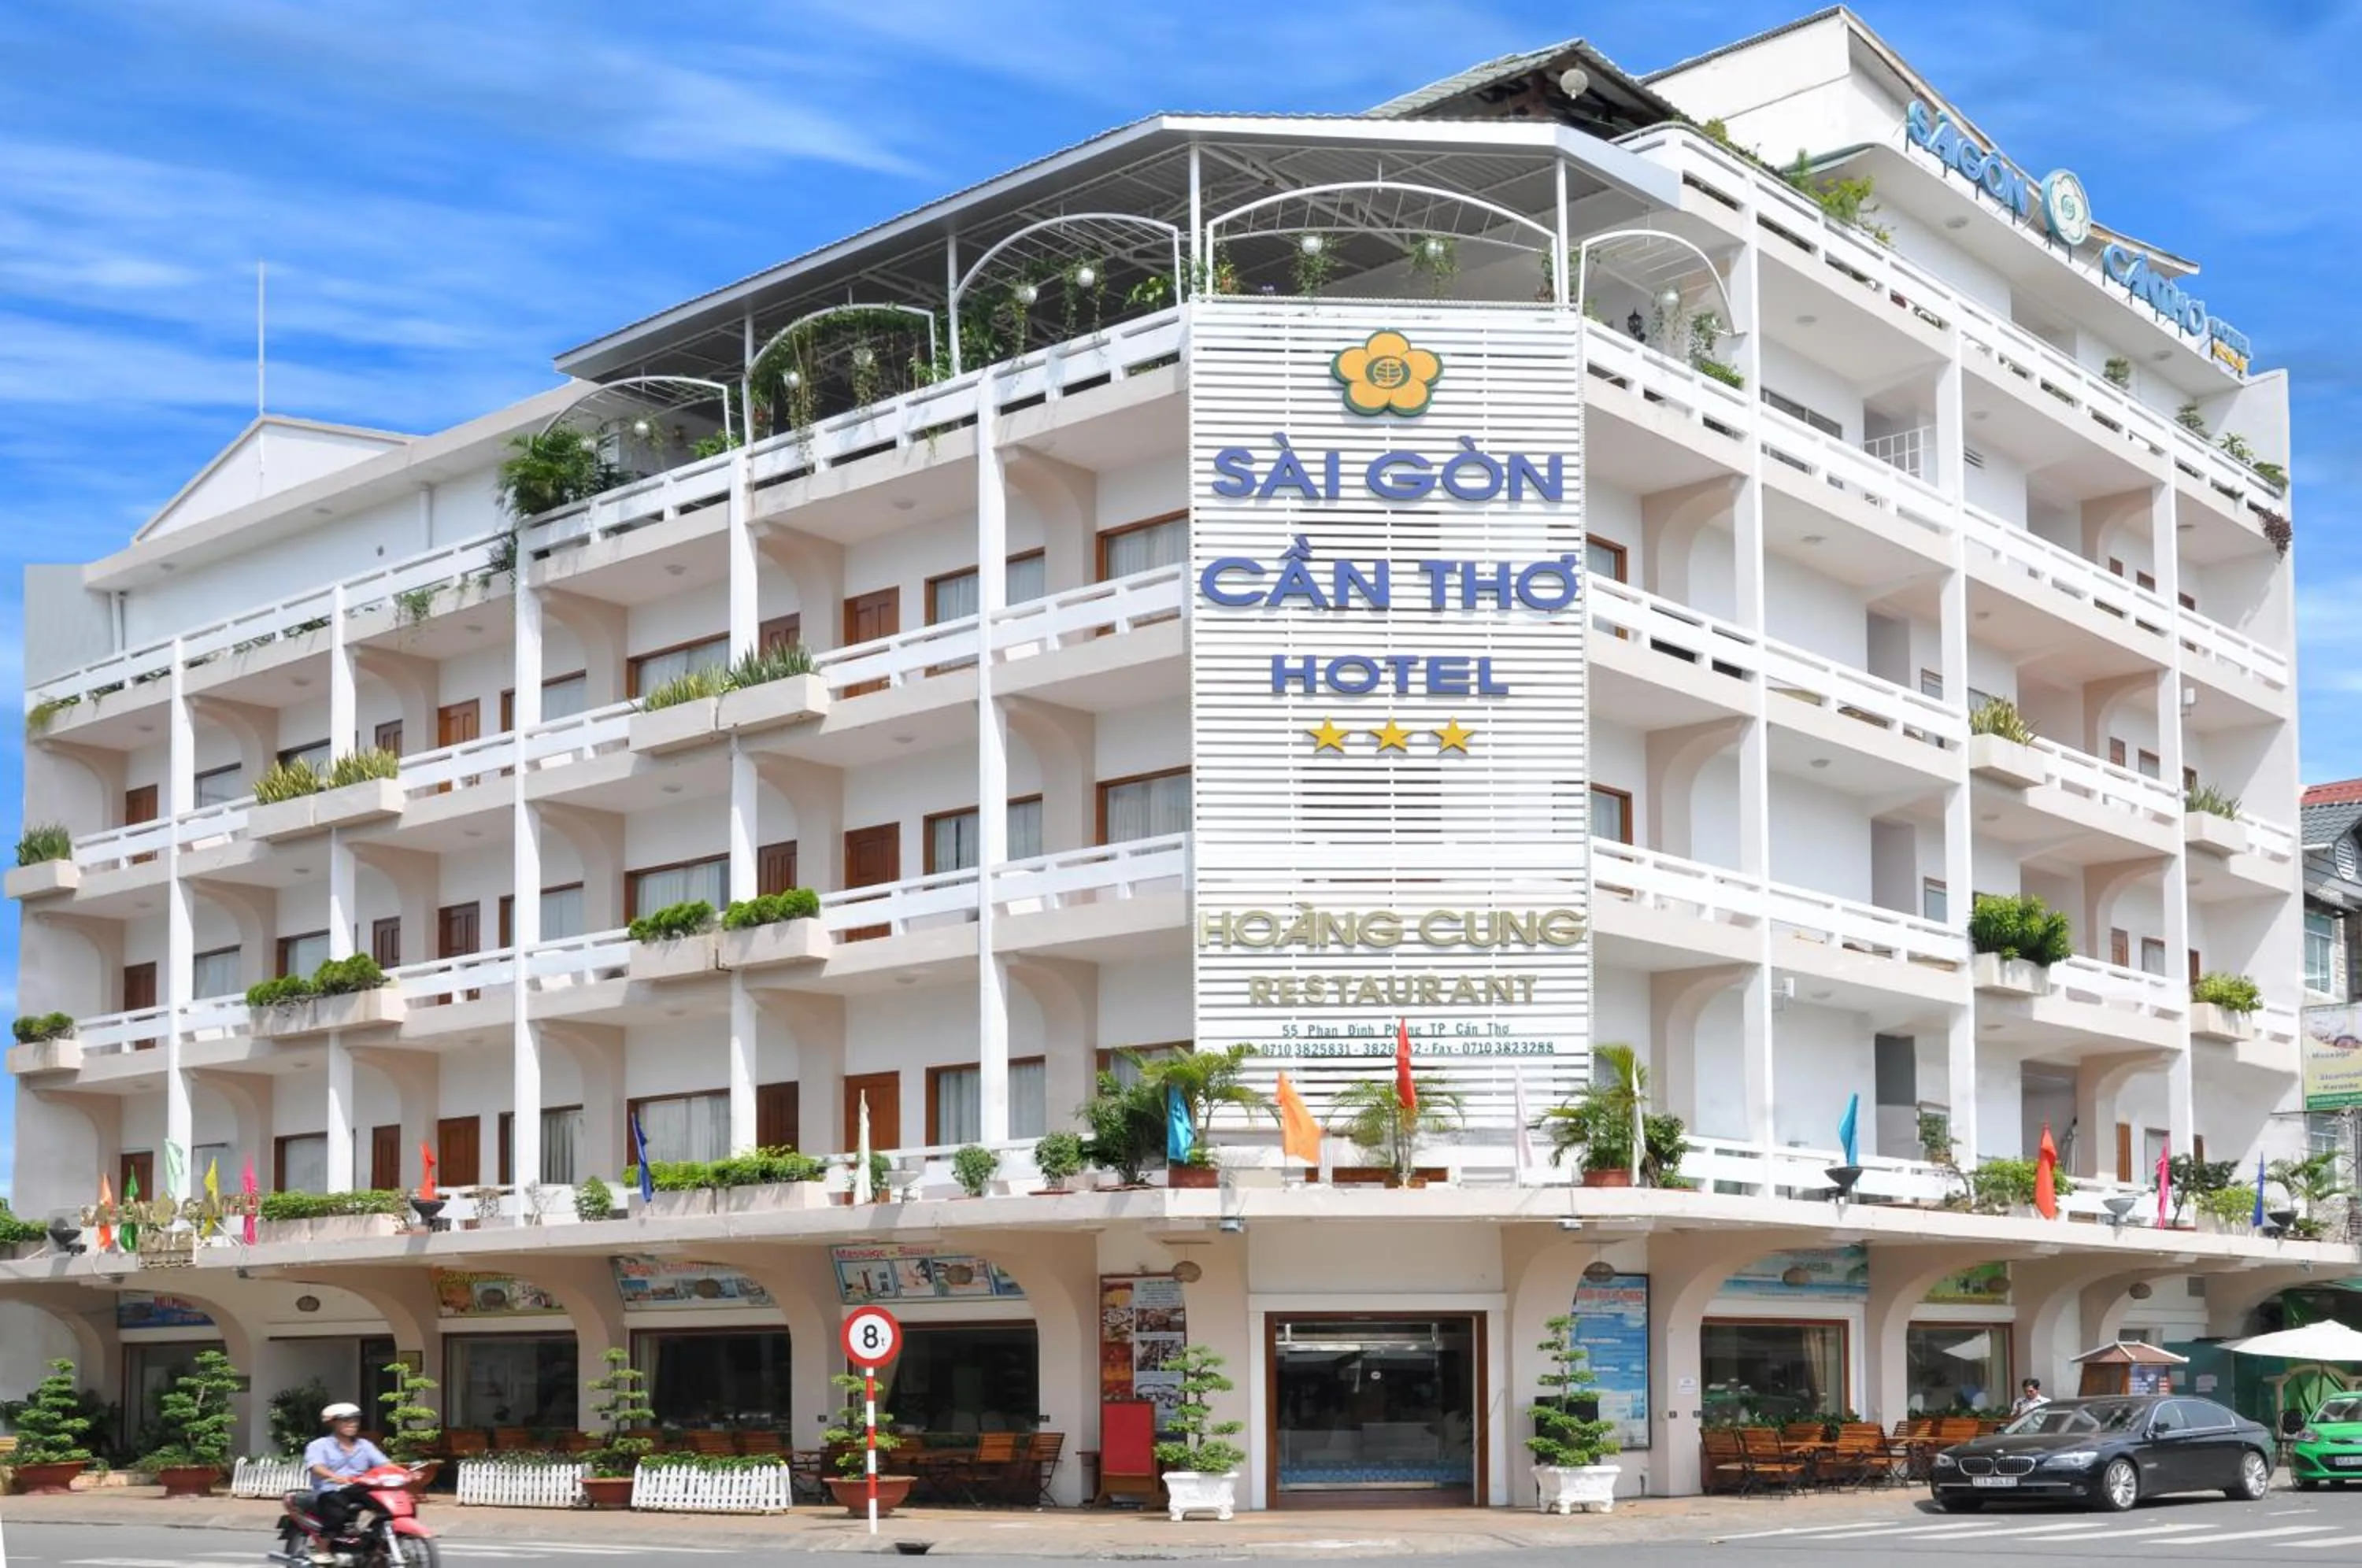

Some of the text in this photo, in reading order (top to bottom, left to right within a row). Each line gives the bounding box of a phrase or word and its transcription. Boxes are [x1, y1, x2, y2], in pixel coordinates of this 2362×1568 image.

[1212, 431, 1564, 502] SÀI GÒN
[1200, 534, 1579, 611] CẦN THƠ
[1271, 654, 1509, 695] HOTEL
[1198, 901, 1587, 948] HOÀNG CUNG
[1249, 974, 1538, 1008] RESTAURANT
[1282, 1024, 1298, 1037] 55
[1307, 1024, 1338, 1037] Phan
[1383, 1023, 1421, 1037] Phng
